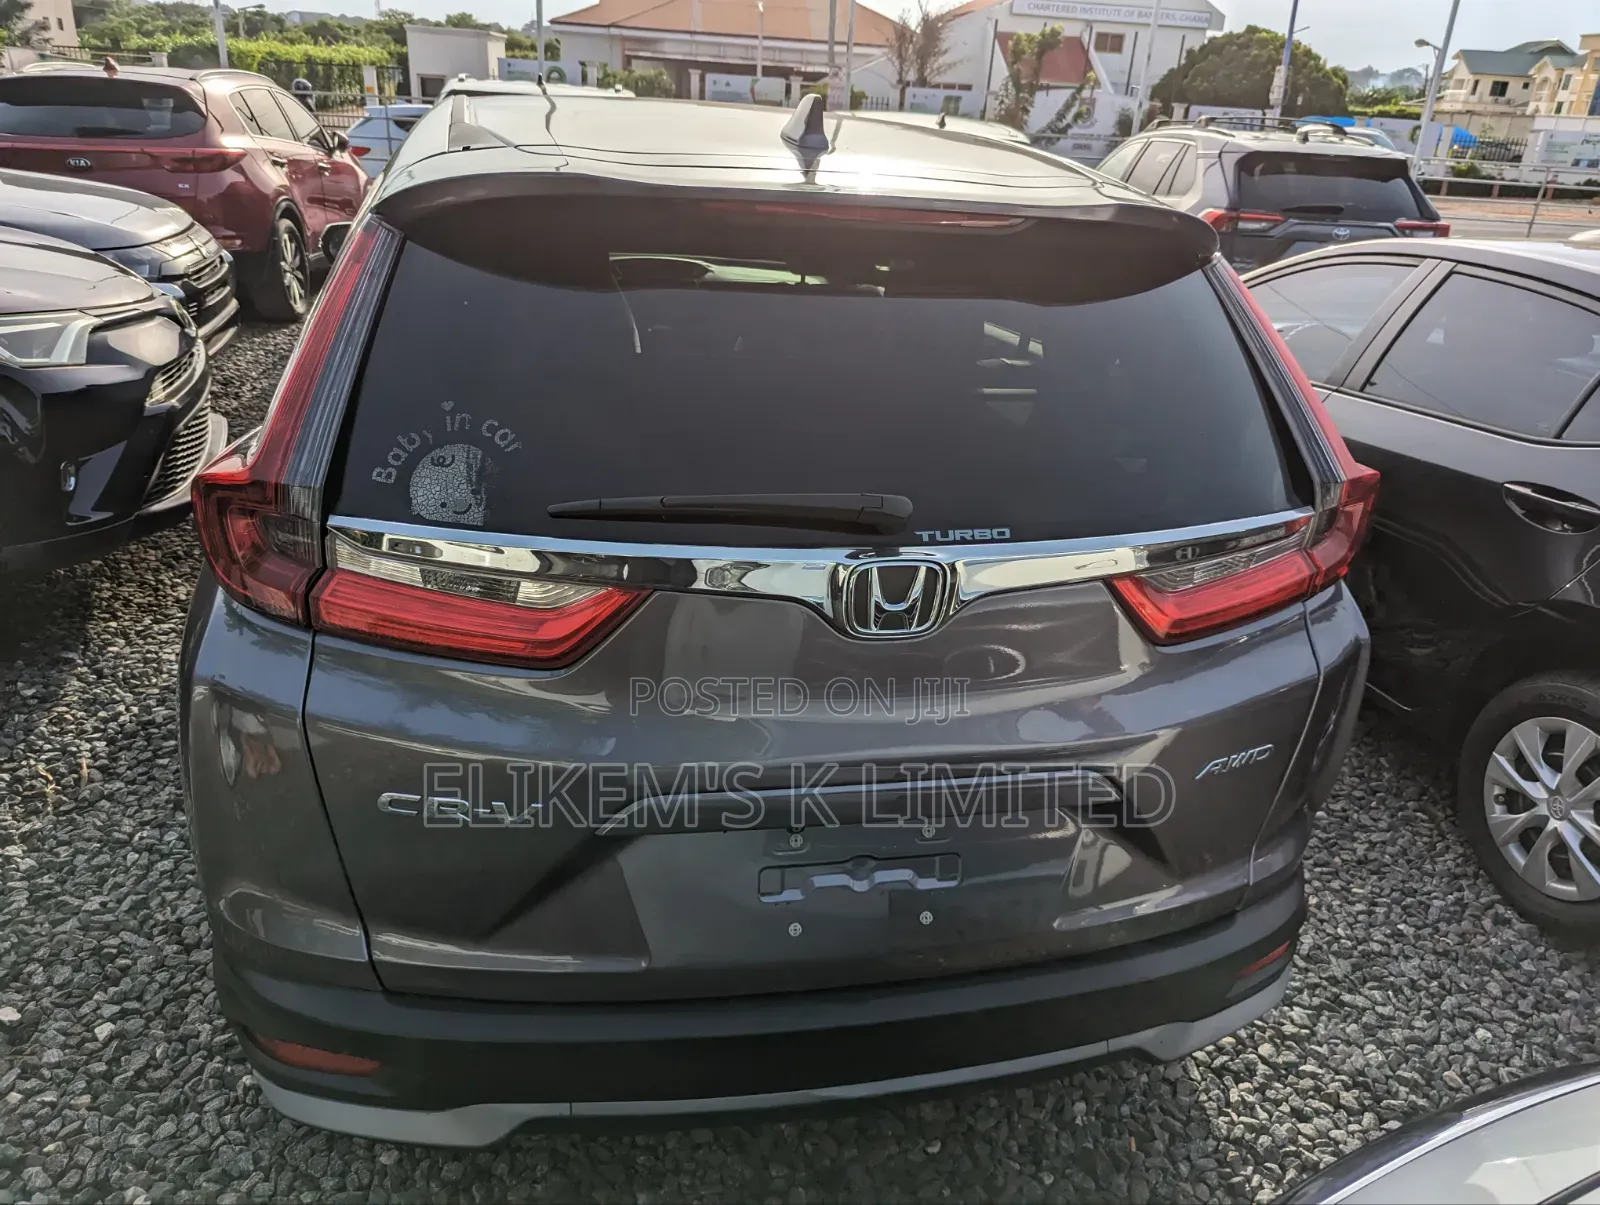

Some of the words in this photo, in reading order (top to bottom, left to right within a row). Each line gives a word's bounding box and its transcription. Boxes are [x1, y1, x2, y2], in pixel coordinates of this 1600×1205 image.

[1027, 2, 1078, 14] CHARTERED
[1080, 6, 1121, 17] INSTITUTE
[1124, 8, 1134, 18] OF
[1137, 10, 1178, 24] BANERS,
[371, 424, 433, 485] Baby
[443, 401, 472, 431] in
[481, 419, 522, 452] car
[914, 528, 1011, 542] TURBO
[1195, 744, 1274, 779] AWD
[377, 792, 543, 824] CR-V
